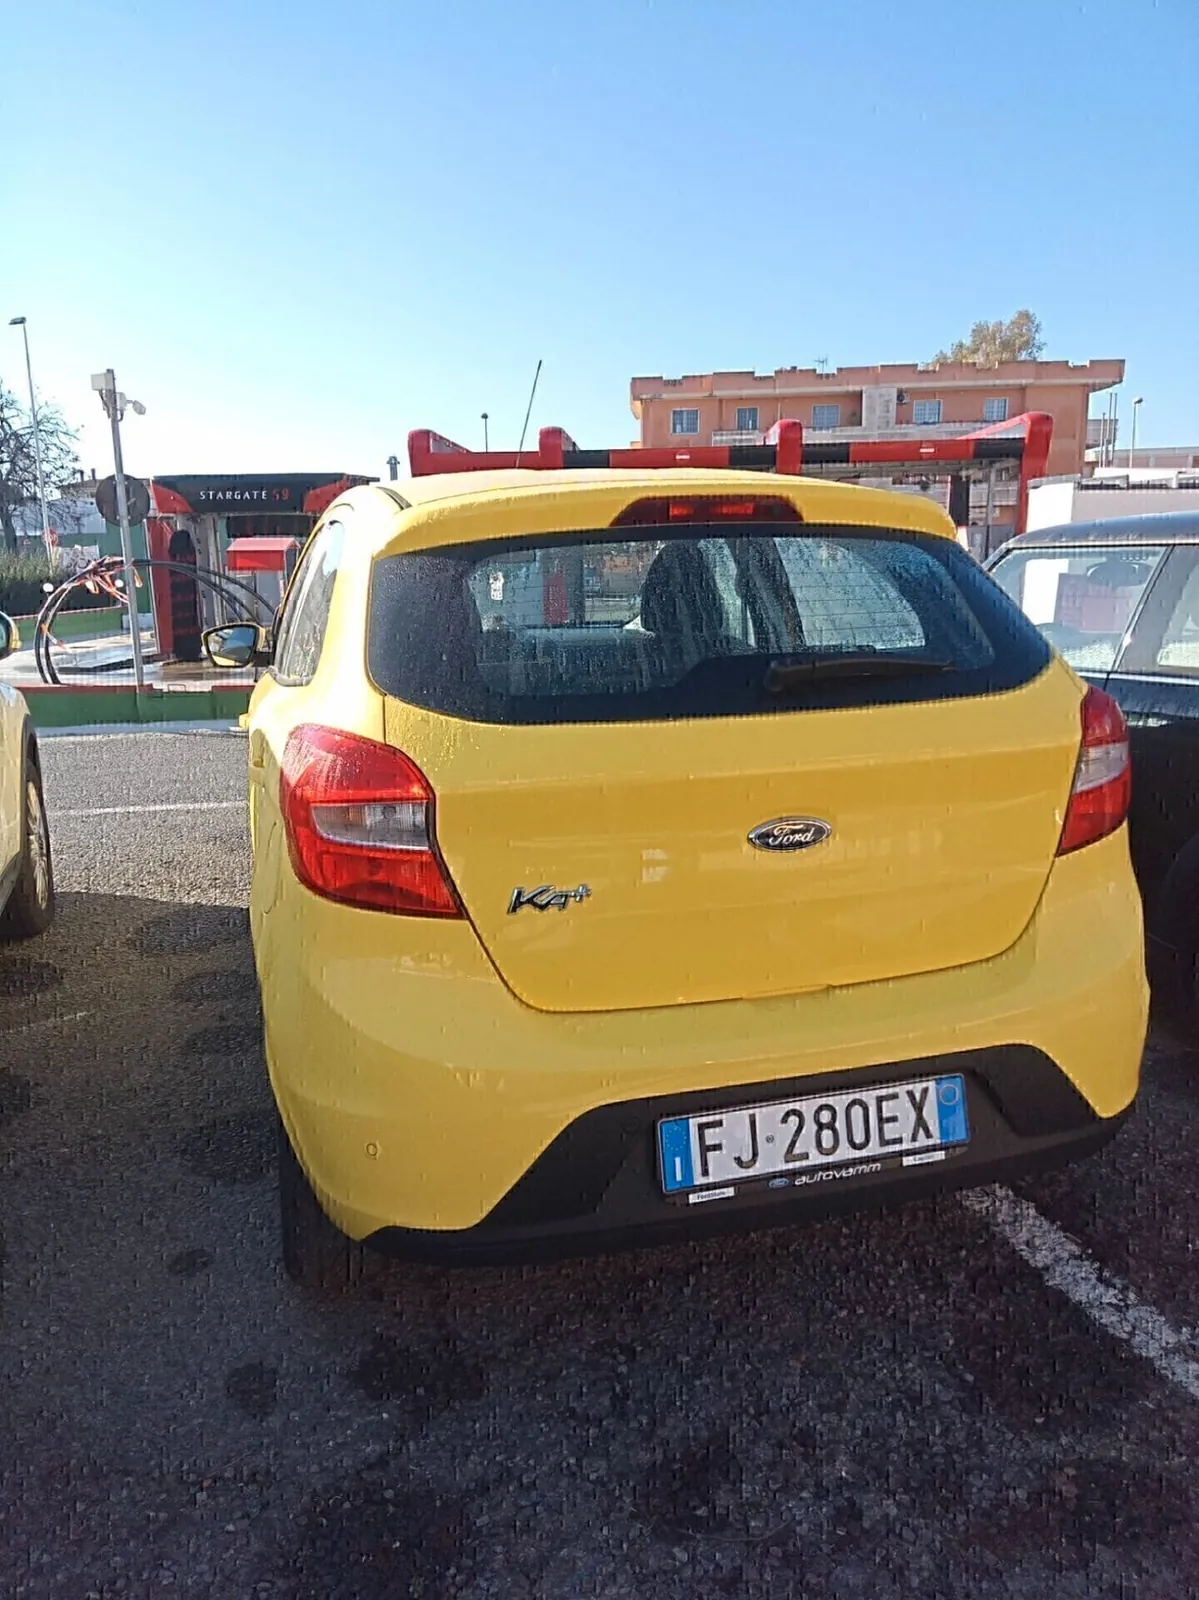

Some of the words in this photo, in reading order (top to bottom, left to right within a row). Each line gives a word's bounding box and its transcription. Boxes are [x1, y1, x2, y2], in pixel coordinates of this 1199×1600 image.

[200, 490, 268, 500] STARGATE
[768, 824, 816, 846] Ford
[506, 884, 592, 915] Ka+
